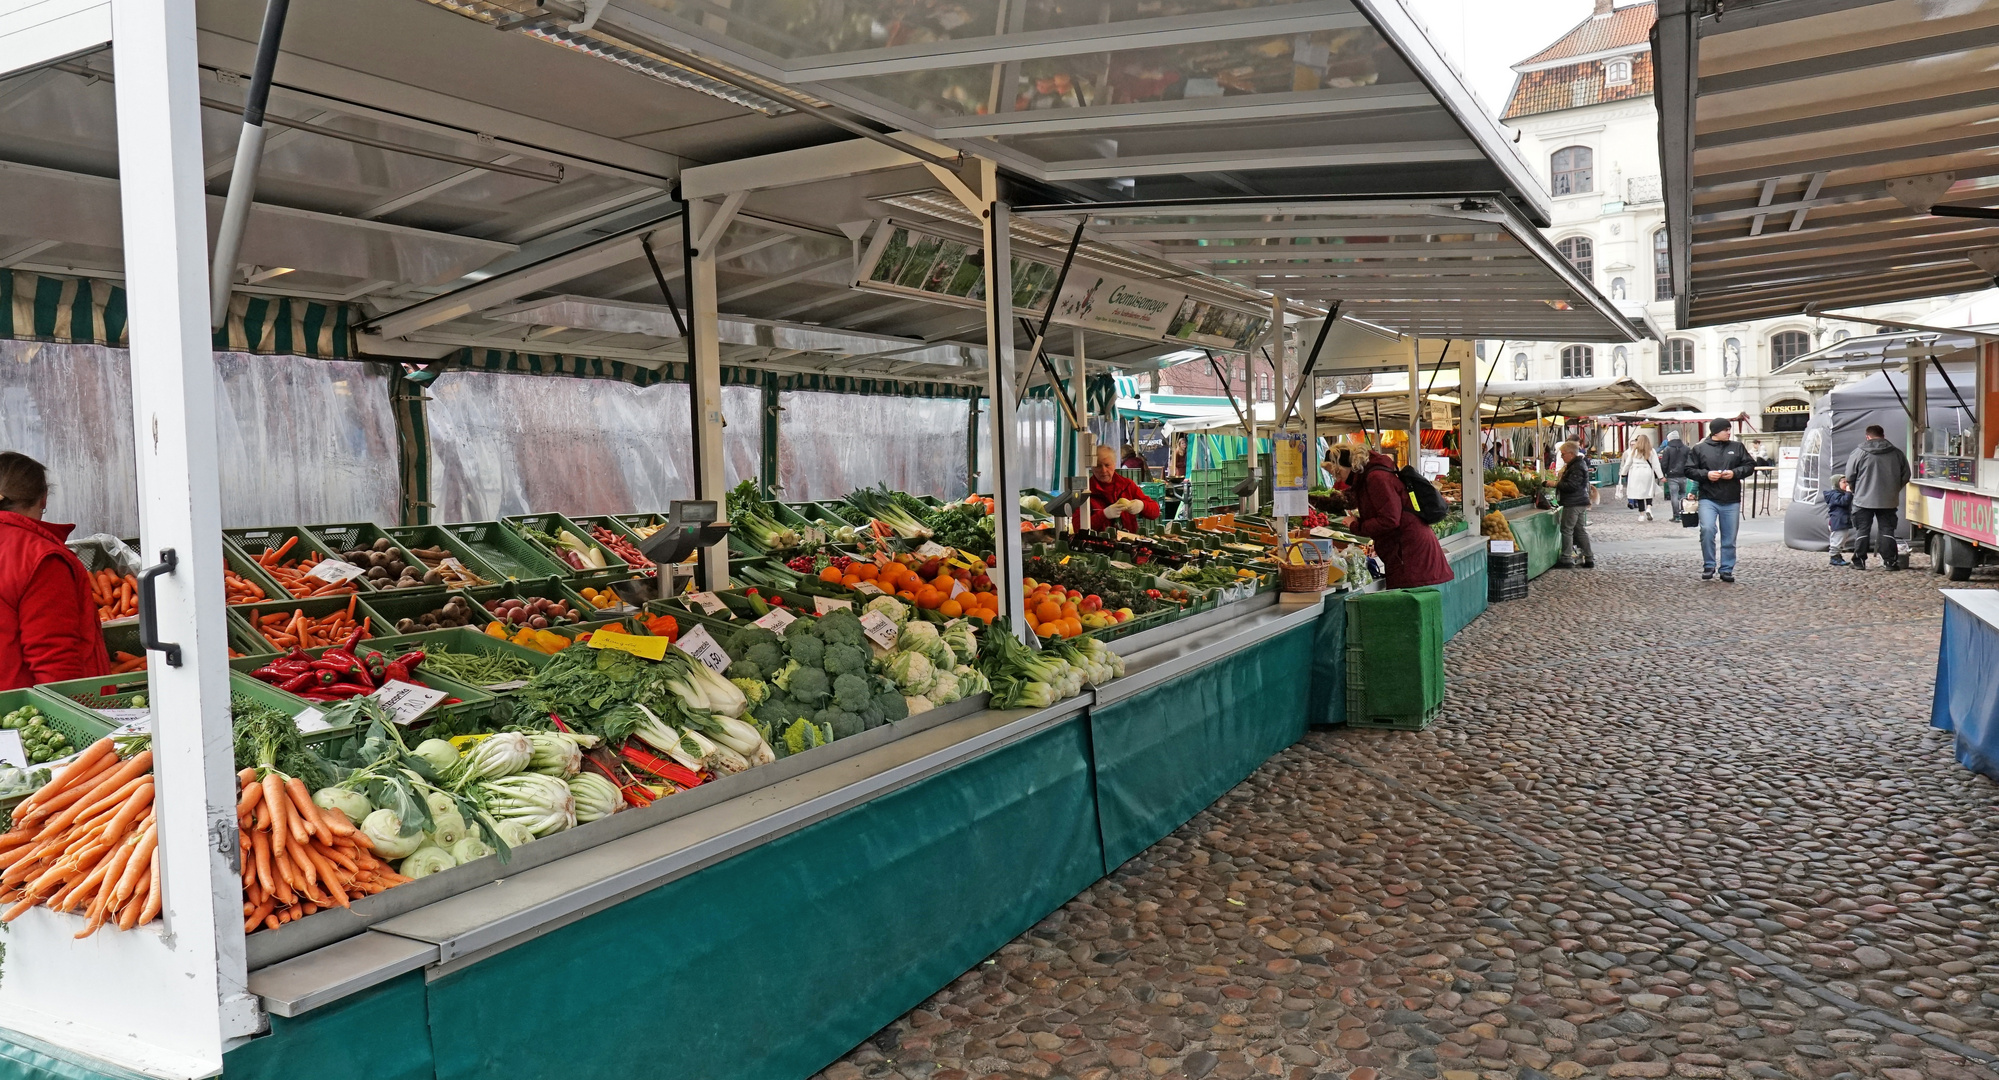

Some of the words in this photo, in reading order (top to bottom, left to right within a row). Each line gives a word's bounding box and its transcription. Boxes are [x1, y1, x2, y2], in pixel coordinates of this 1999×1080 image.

[1108, 284, 1169, 316] Gemüsemeyer
[1951, 498, 1967, 528] WE
[1970, 502, 1999, 536] LOVE
[396, 698, 427, 714] 7,80
